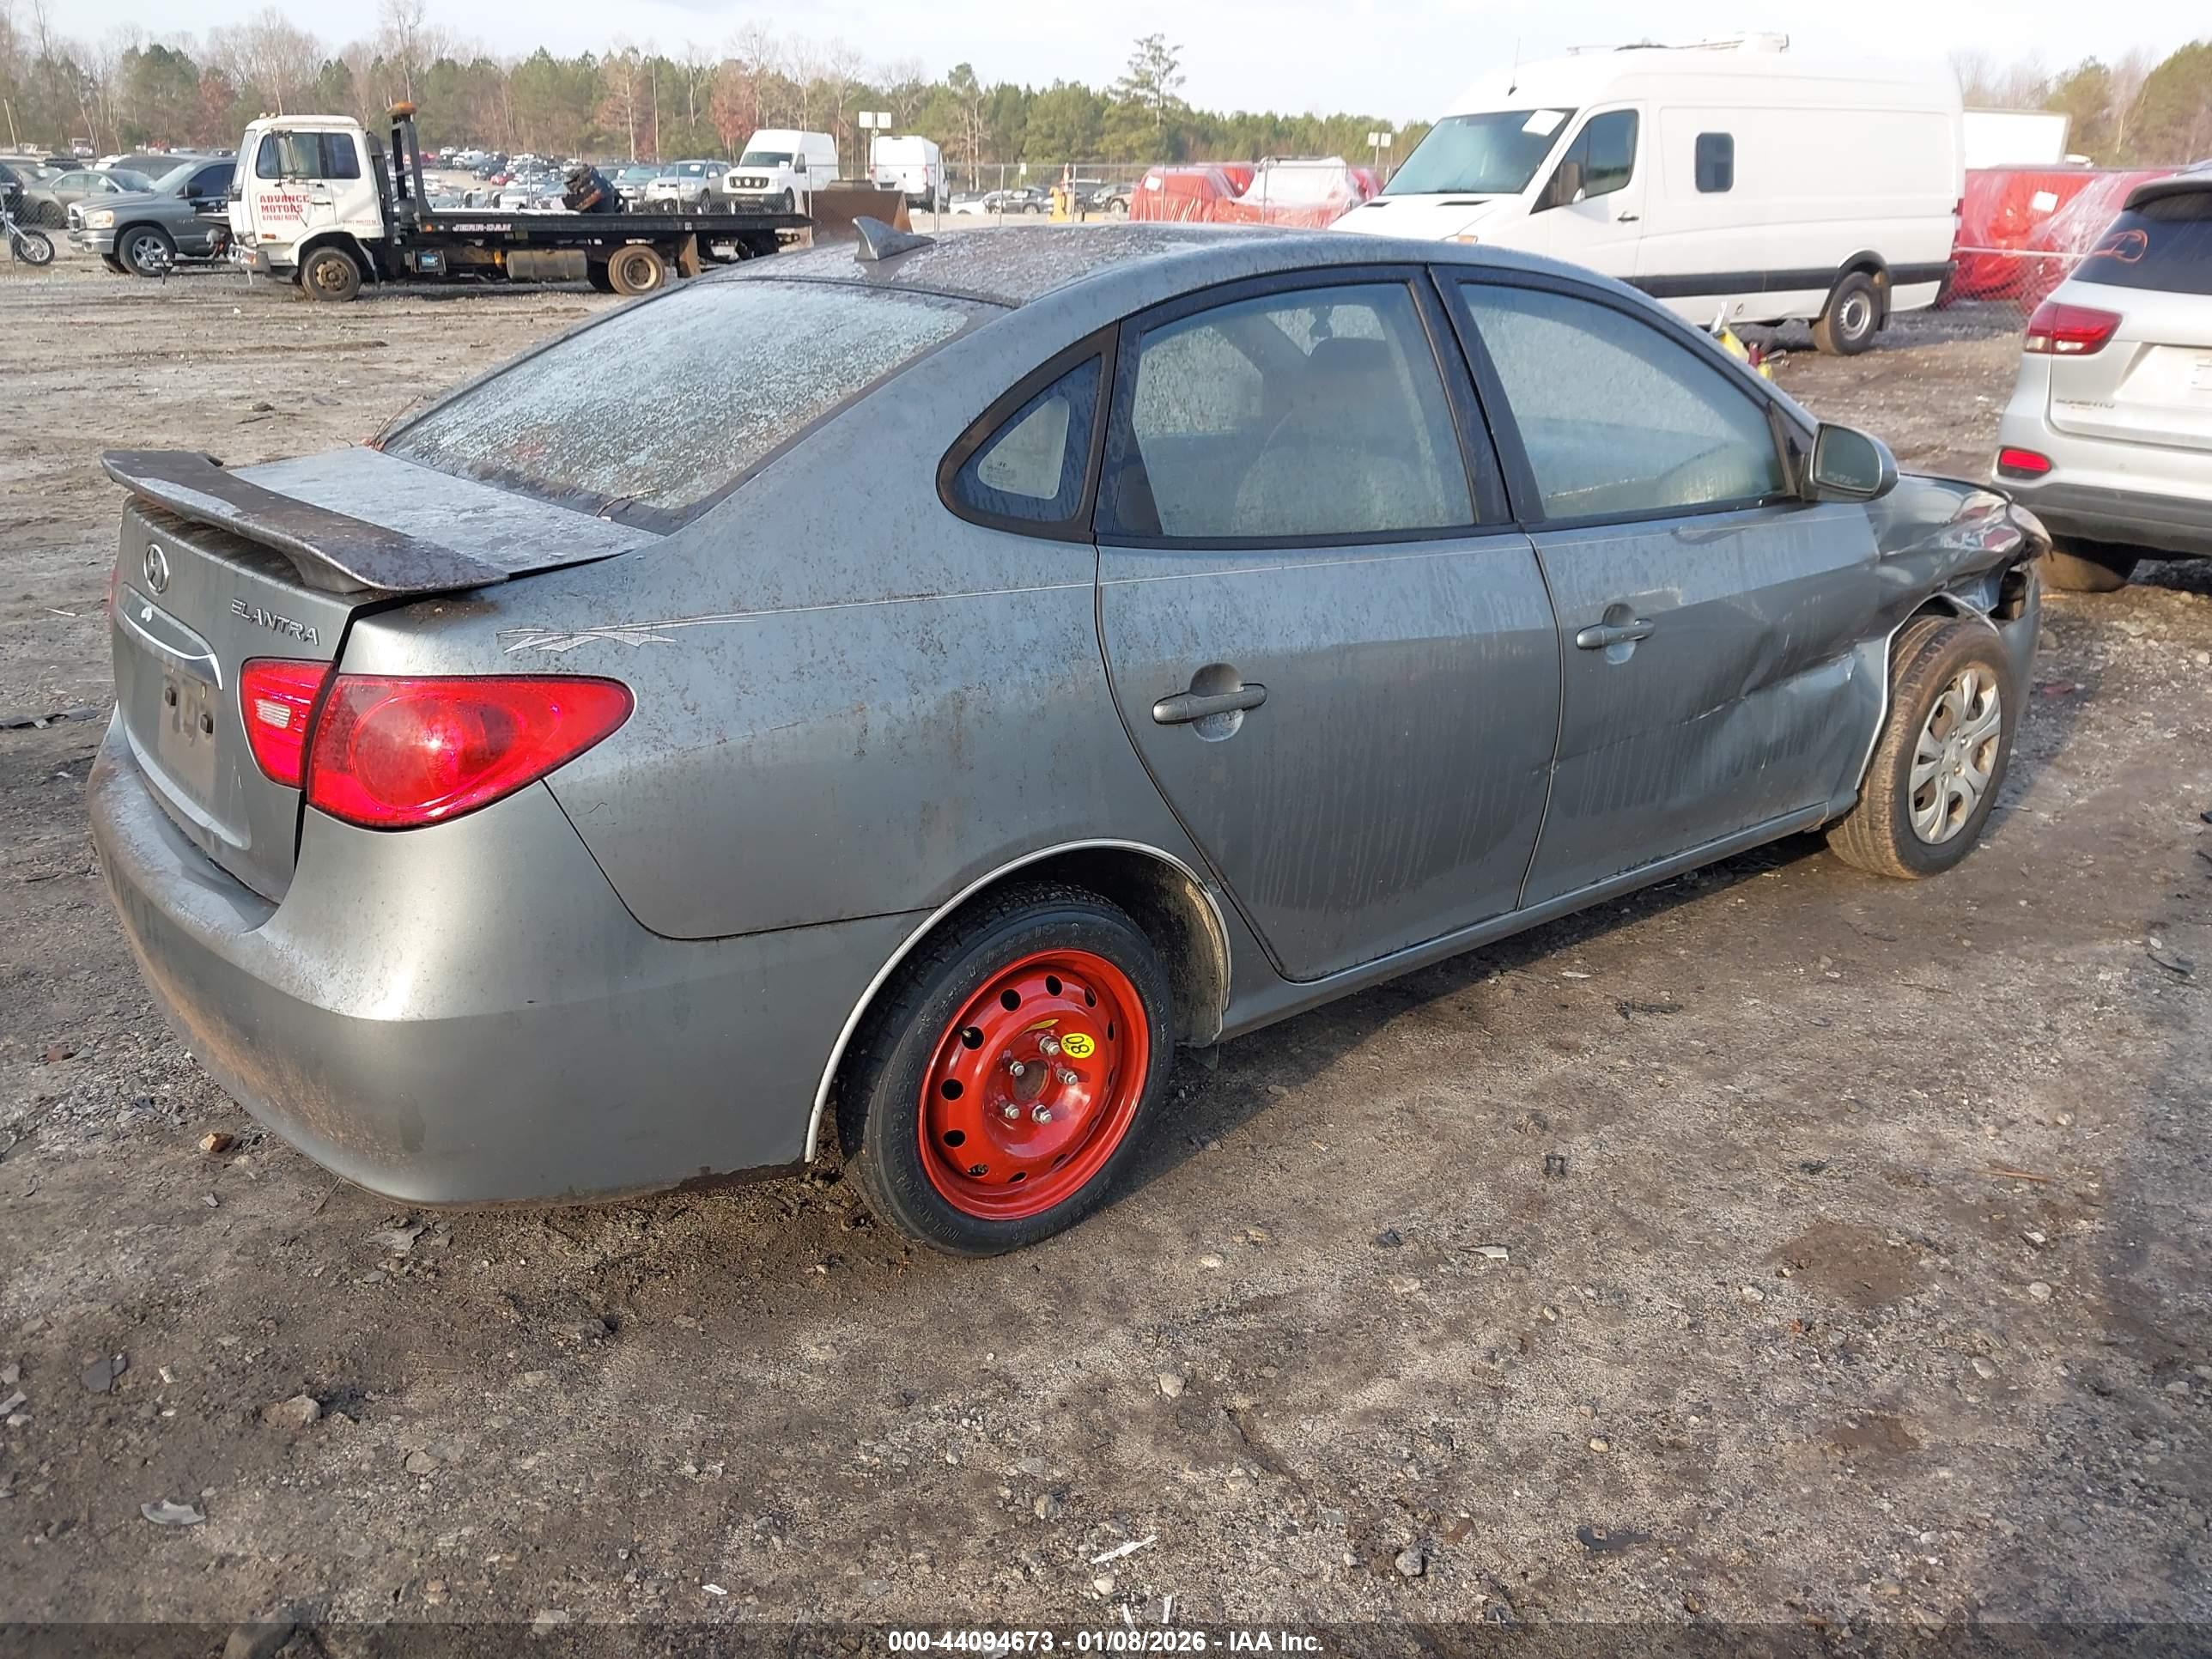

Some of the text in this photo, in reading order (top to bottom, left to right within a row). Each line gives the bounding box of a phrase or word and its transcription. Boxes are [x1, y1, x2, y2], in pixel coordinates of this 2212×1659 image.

[260, 194, 310, 204] ADVANCE
[261, 204, 303, 214] MOTORS
[230, 599, 320, 646] ELANTRA
[1065, 1036, 1091, 1054] 80
